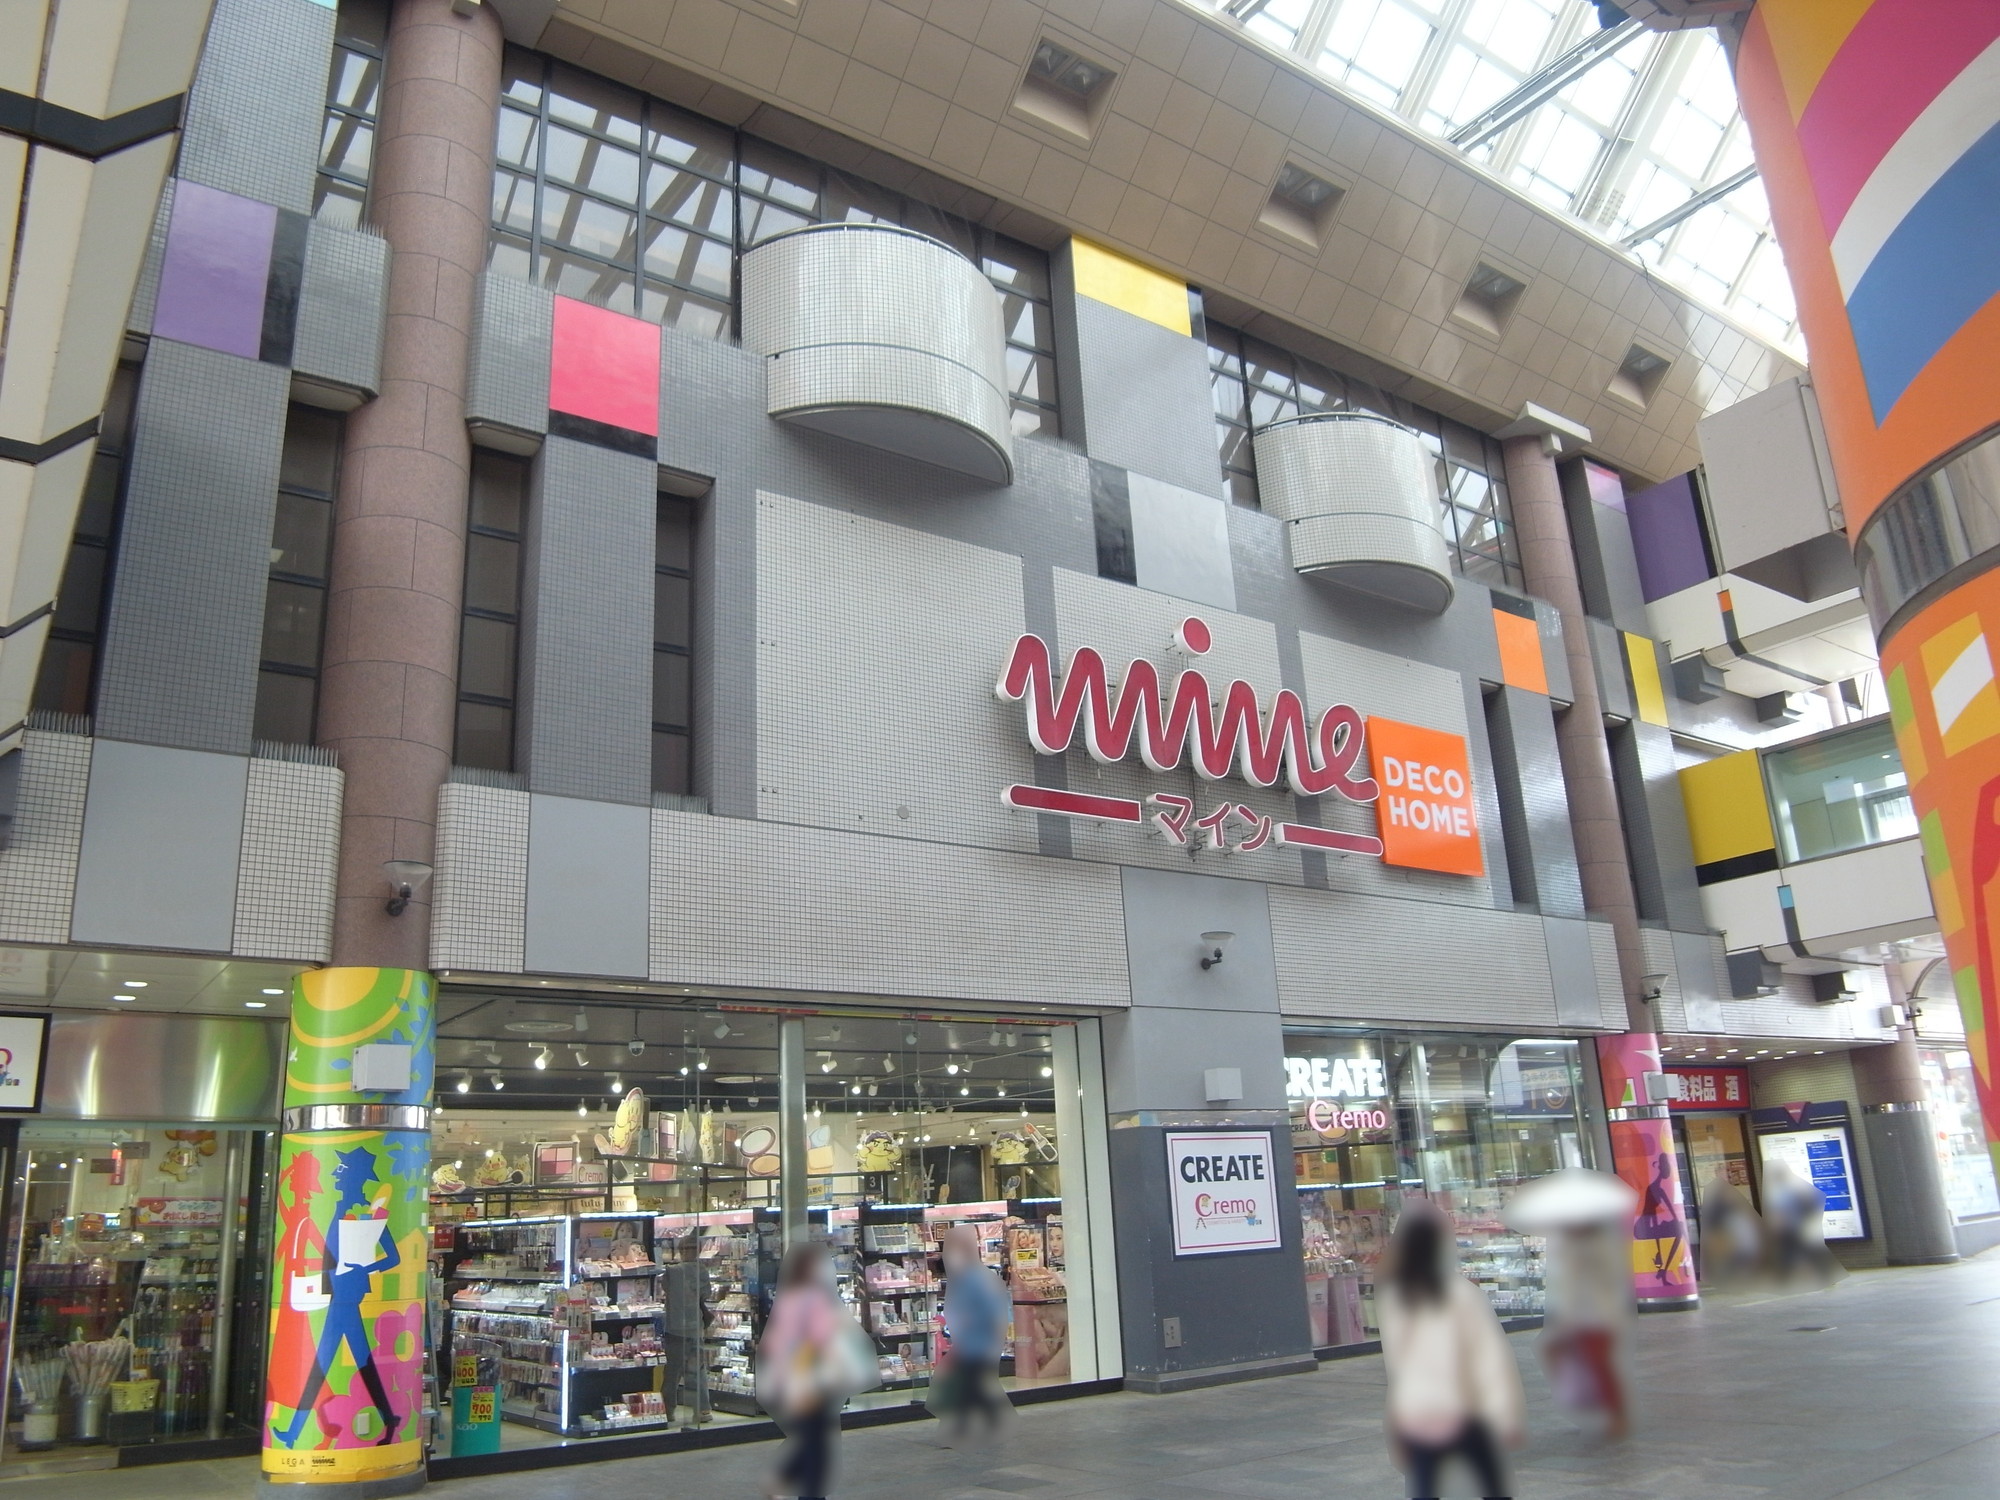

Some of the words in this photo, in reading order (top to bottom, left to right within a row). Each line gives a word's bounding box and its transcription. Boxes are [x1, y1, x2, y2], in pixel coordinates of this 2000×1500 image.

[1382, 756, 1465, 799] DECO
[1146, 792, 1272, 853] マイン
[1389, 800, 1472, 839] HOME
[1308, 1100, 1386, 1132] Cremo
[579, 1166, 604, 1183] Cremo
[869, 1176, 877, 1188] 3
[1180, 1154, 1264, 1183] CREATE
[1195, 1193, 1256, 1217] Cremo
[472, 1403, 492, 1415] 700
